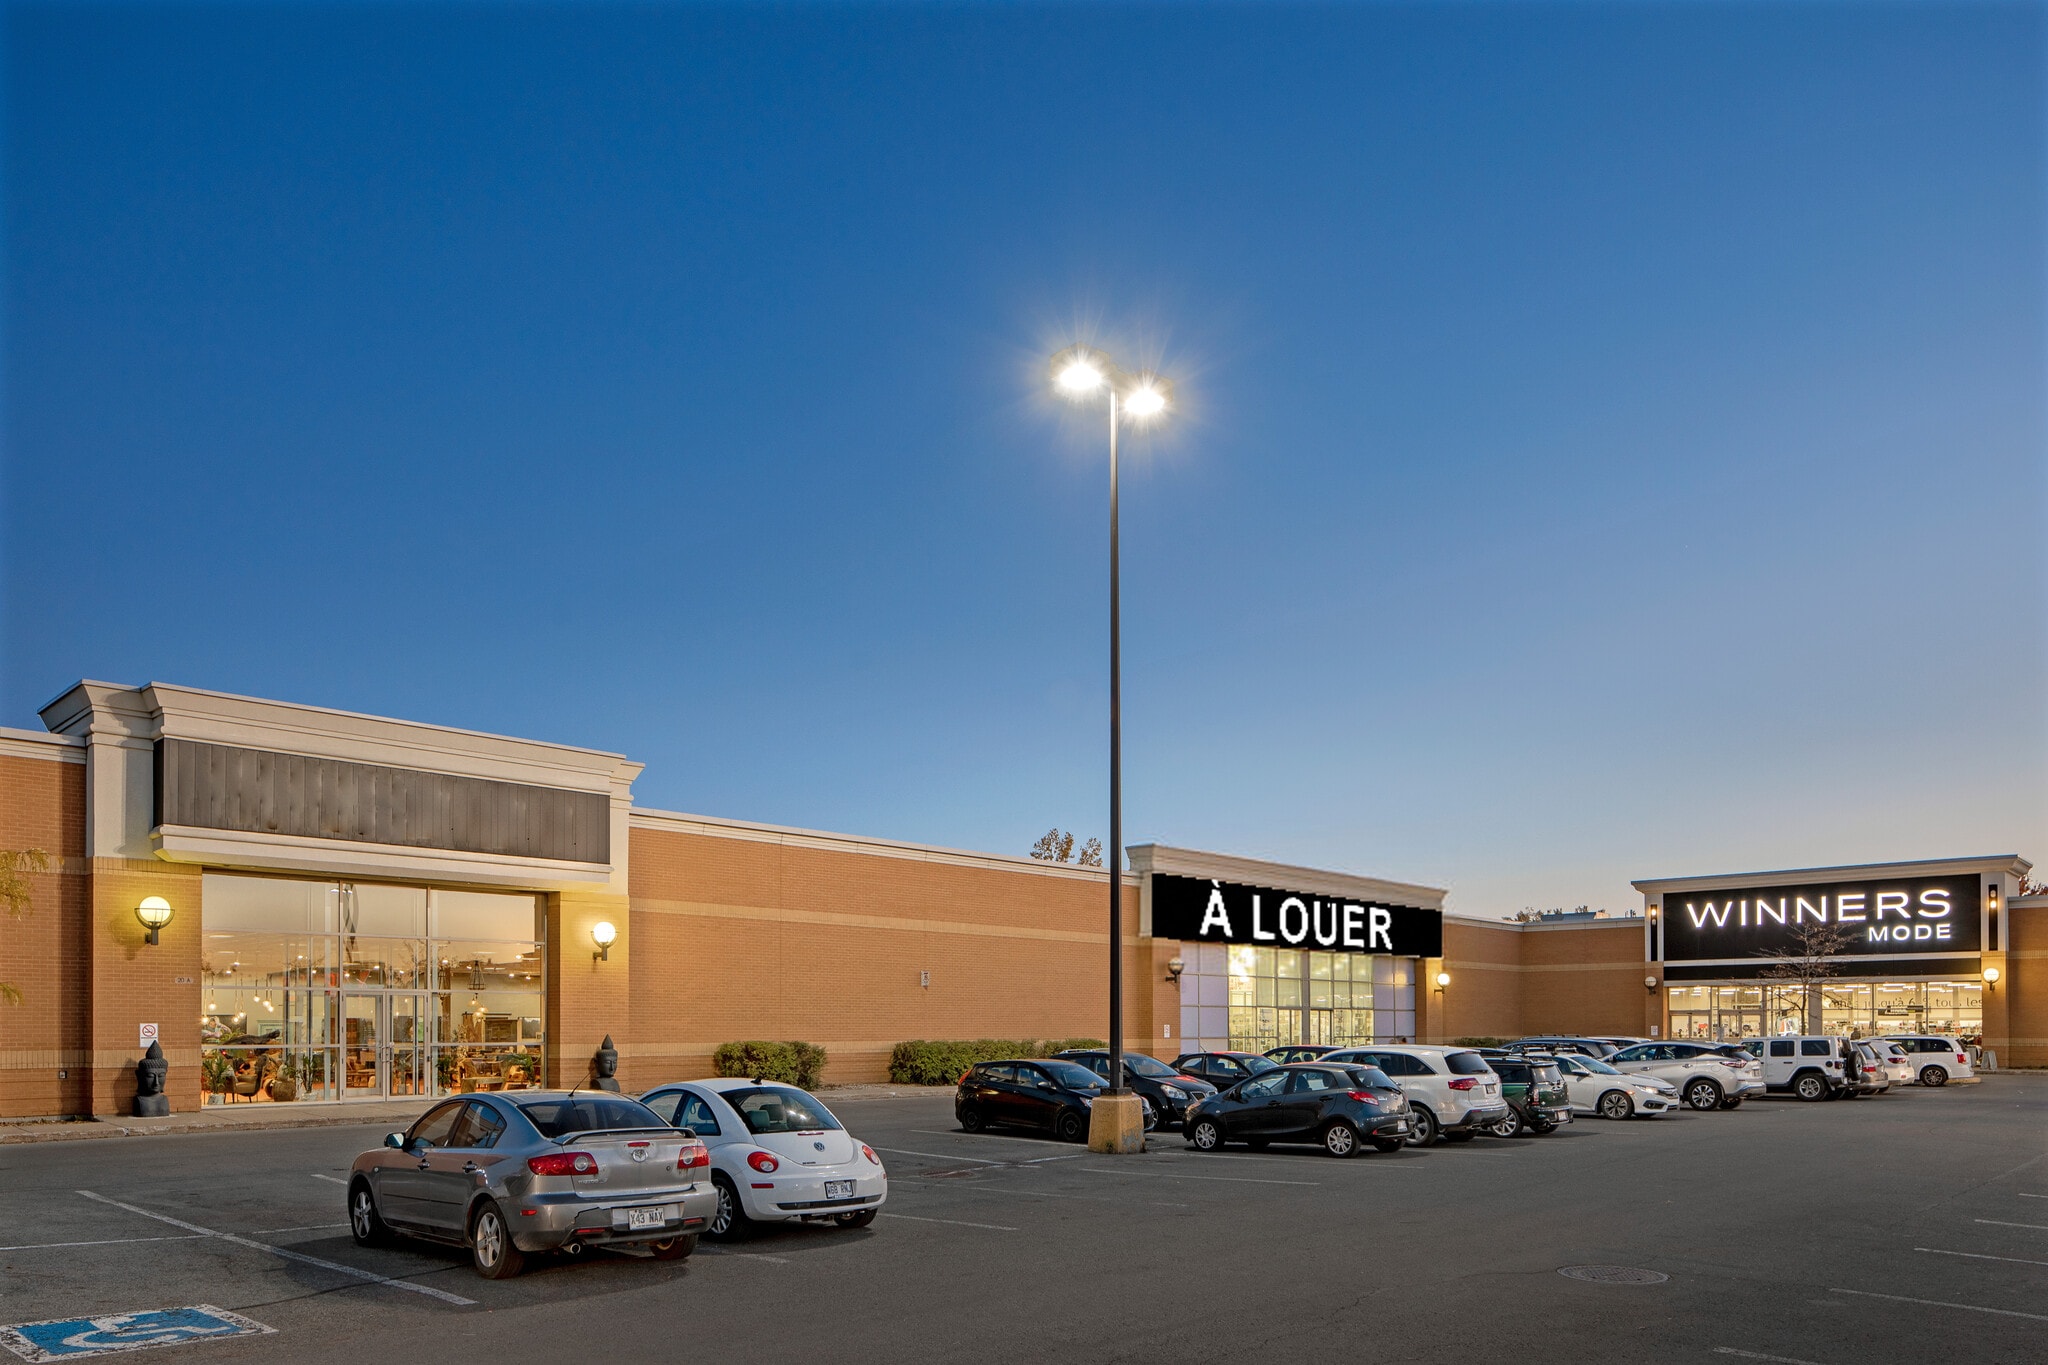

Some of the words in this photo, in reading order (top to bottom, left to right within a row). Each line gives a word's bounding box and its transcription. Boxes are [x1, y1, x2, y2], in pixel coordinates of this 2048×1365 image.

[1200, 879, 1233, 938] À
[1252, 894, 1393, 950] LOUER
[1686, 888, 1951, 928] WINNERS
[1868, 923, 1951, 942] MODE
[1936, 998, 1962, 1008] tou
[630, 1213, 645, 1225] X43
[649, 1211, 663, 1223] NAX
